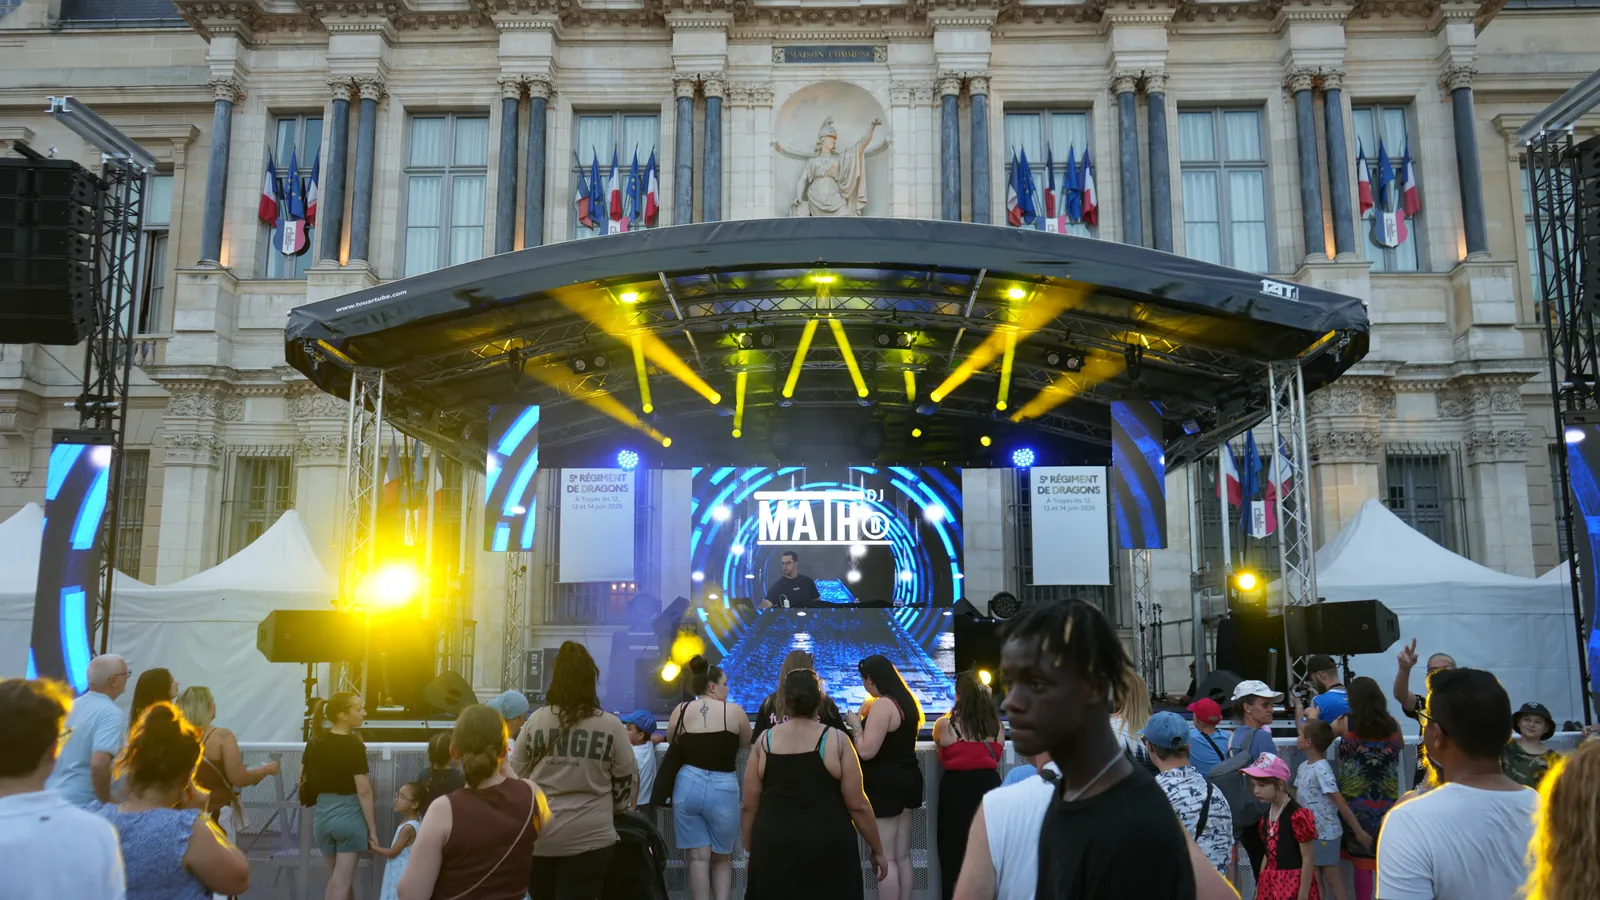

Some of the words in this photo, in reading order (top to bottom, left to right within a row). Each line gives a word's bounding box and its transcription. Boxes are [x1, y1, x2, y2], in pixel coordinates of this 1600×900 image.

[580, 472, 627, 482] RÉGIMENT
[1050, 473, 1098, 483] RÉGIMENT
[567, 485, 579, 493] DE
[581, 484, 628, 493] DRAGONS
[1037, 486, 1050, 494] DE
[1052, 486, 1101, 494] DRAGONS
[867, 489, 884, 502] DJ
